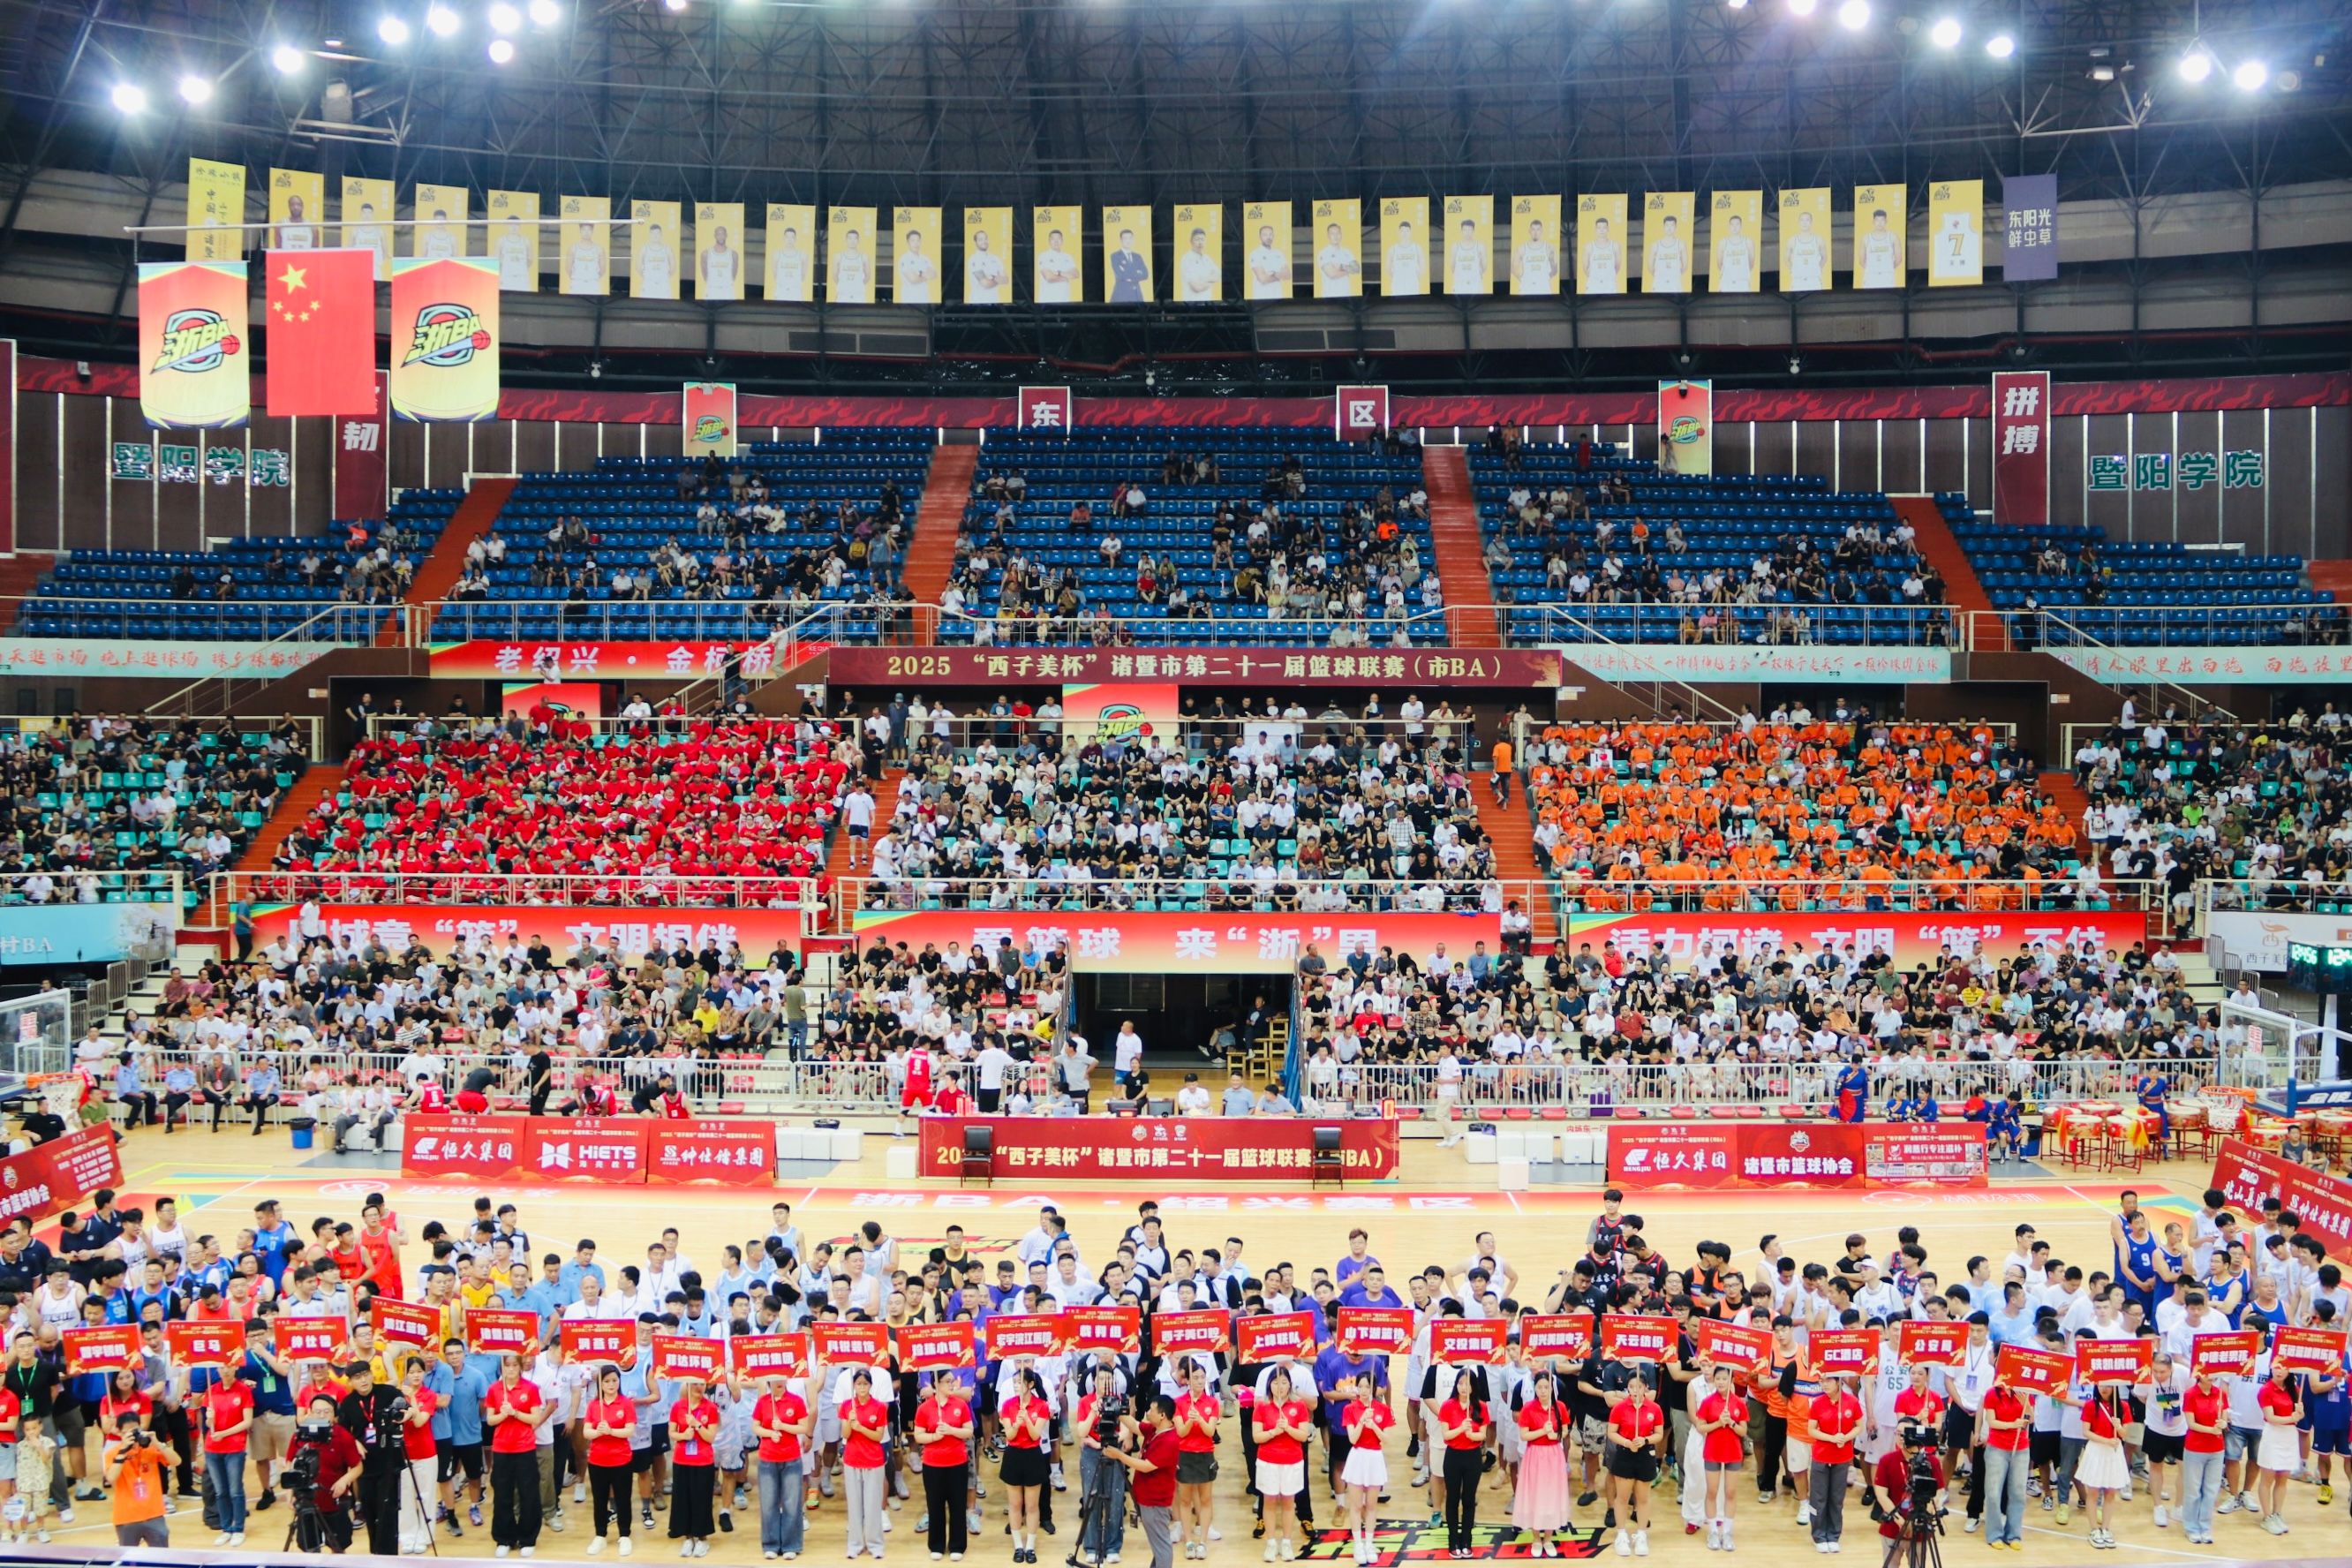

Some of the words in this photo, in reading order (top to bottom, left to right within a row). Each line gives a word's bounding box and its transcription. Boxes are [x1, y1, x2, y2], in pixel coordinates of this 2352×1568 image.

[2009, 208, 2052, 227] 东阳光
[1949, 233, 1964, 256] 7
[2009, 229, 2052, 248] 鲜虫草
[1031, 400, 1061, 428] 东
[1348, 400, 1376, 428] 区
[2001, 386, 2039, 456] 拼搏
[112, 441, 290, 486] 暨阳学院
[2087, 450, 2265, 492] 暨阳学院
[0, 648, 88, 666] 天逛市场
[887, 656, 952, 676] 2025
[973, 655, 1099, 678] “西子美杯”
[1111, 654, 1503, 679] 诸暨市第二十一届篮球联赛（市BA）
[2246, 953, 2287, 967] 西子美
[441, 1139, 513, 1163] 恒久集团
[995, 1145, 1092, 1167] “西子美杯”
[1652, 1148, 1727, 1172] 恒久集团
[0, 1183, 51, 1218] 市篮球协会
[2141, 1251, 2151, 1264] 9
[1888, 1376, 1903, 1391] 65
